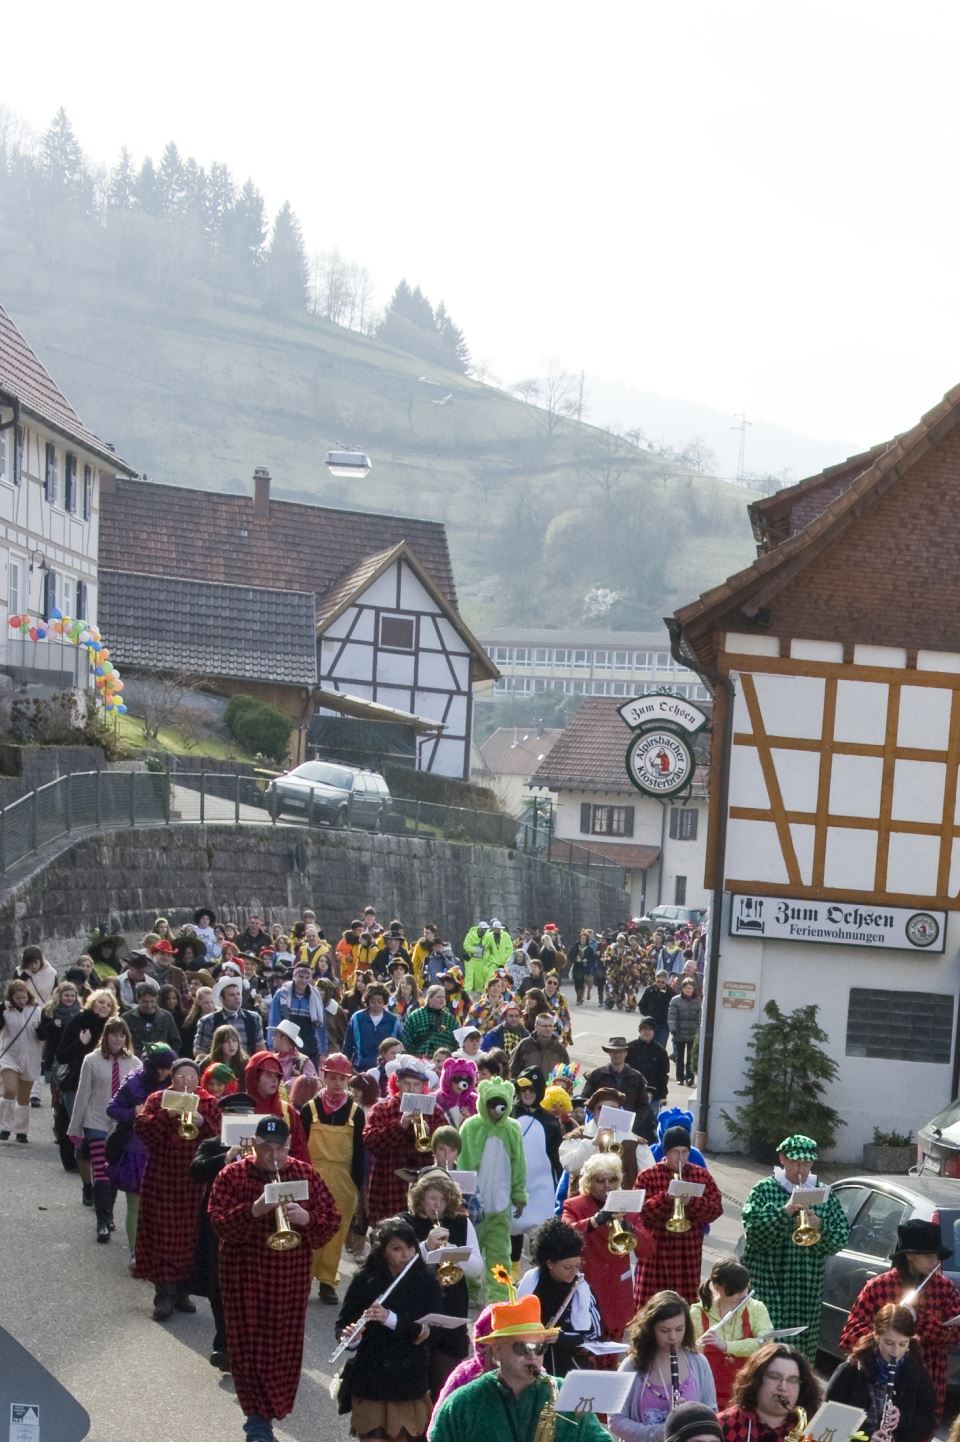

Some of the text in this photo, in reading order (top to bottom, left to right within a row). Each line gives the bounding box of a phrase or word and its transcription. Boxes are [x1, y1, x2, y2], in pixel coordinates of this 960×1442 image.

[631, 702, 696, 724] Zum Ochsen
[636, 735, 685, 763] Alpirsbacher
[637, 765, 684, 788] Klosterbräu
[774, 902, 819, 924] Zum
[827, 906, 895, 930] Ochsen
[789, 923, 885, 943] Ferienwohnungen
